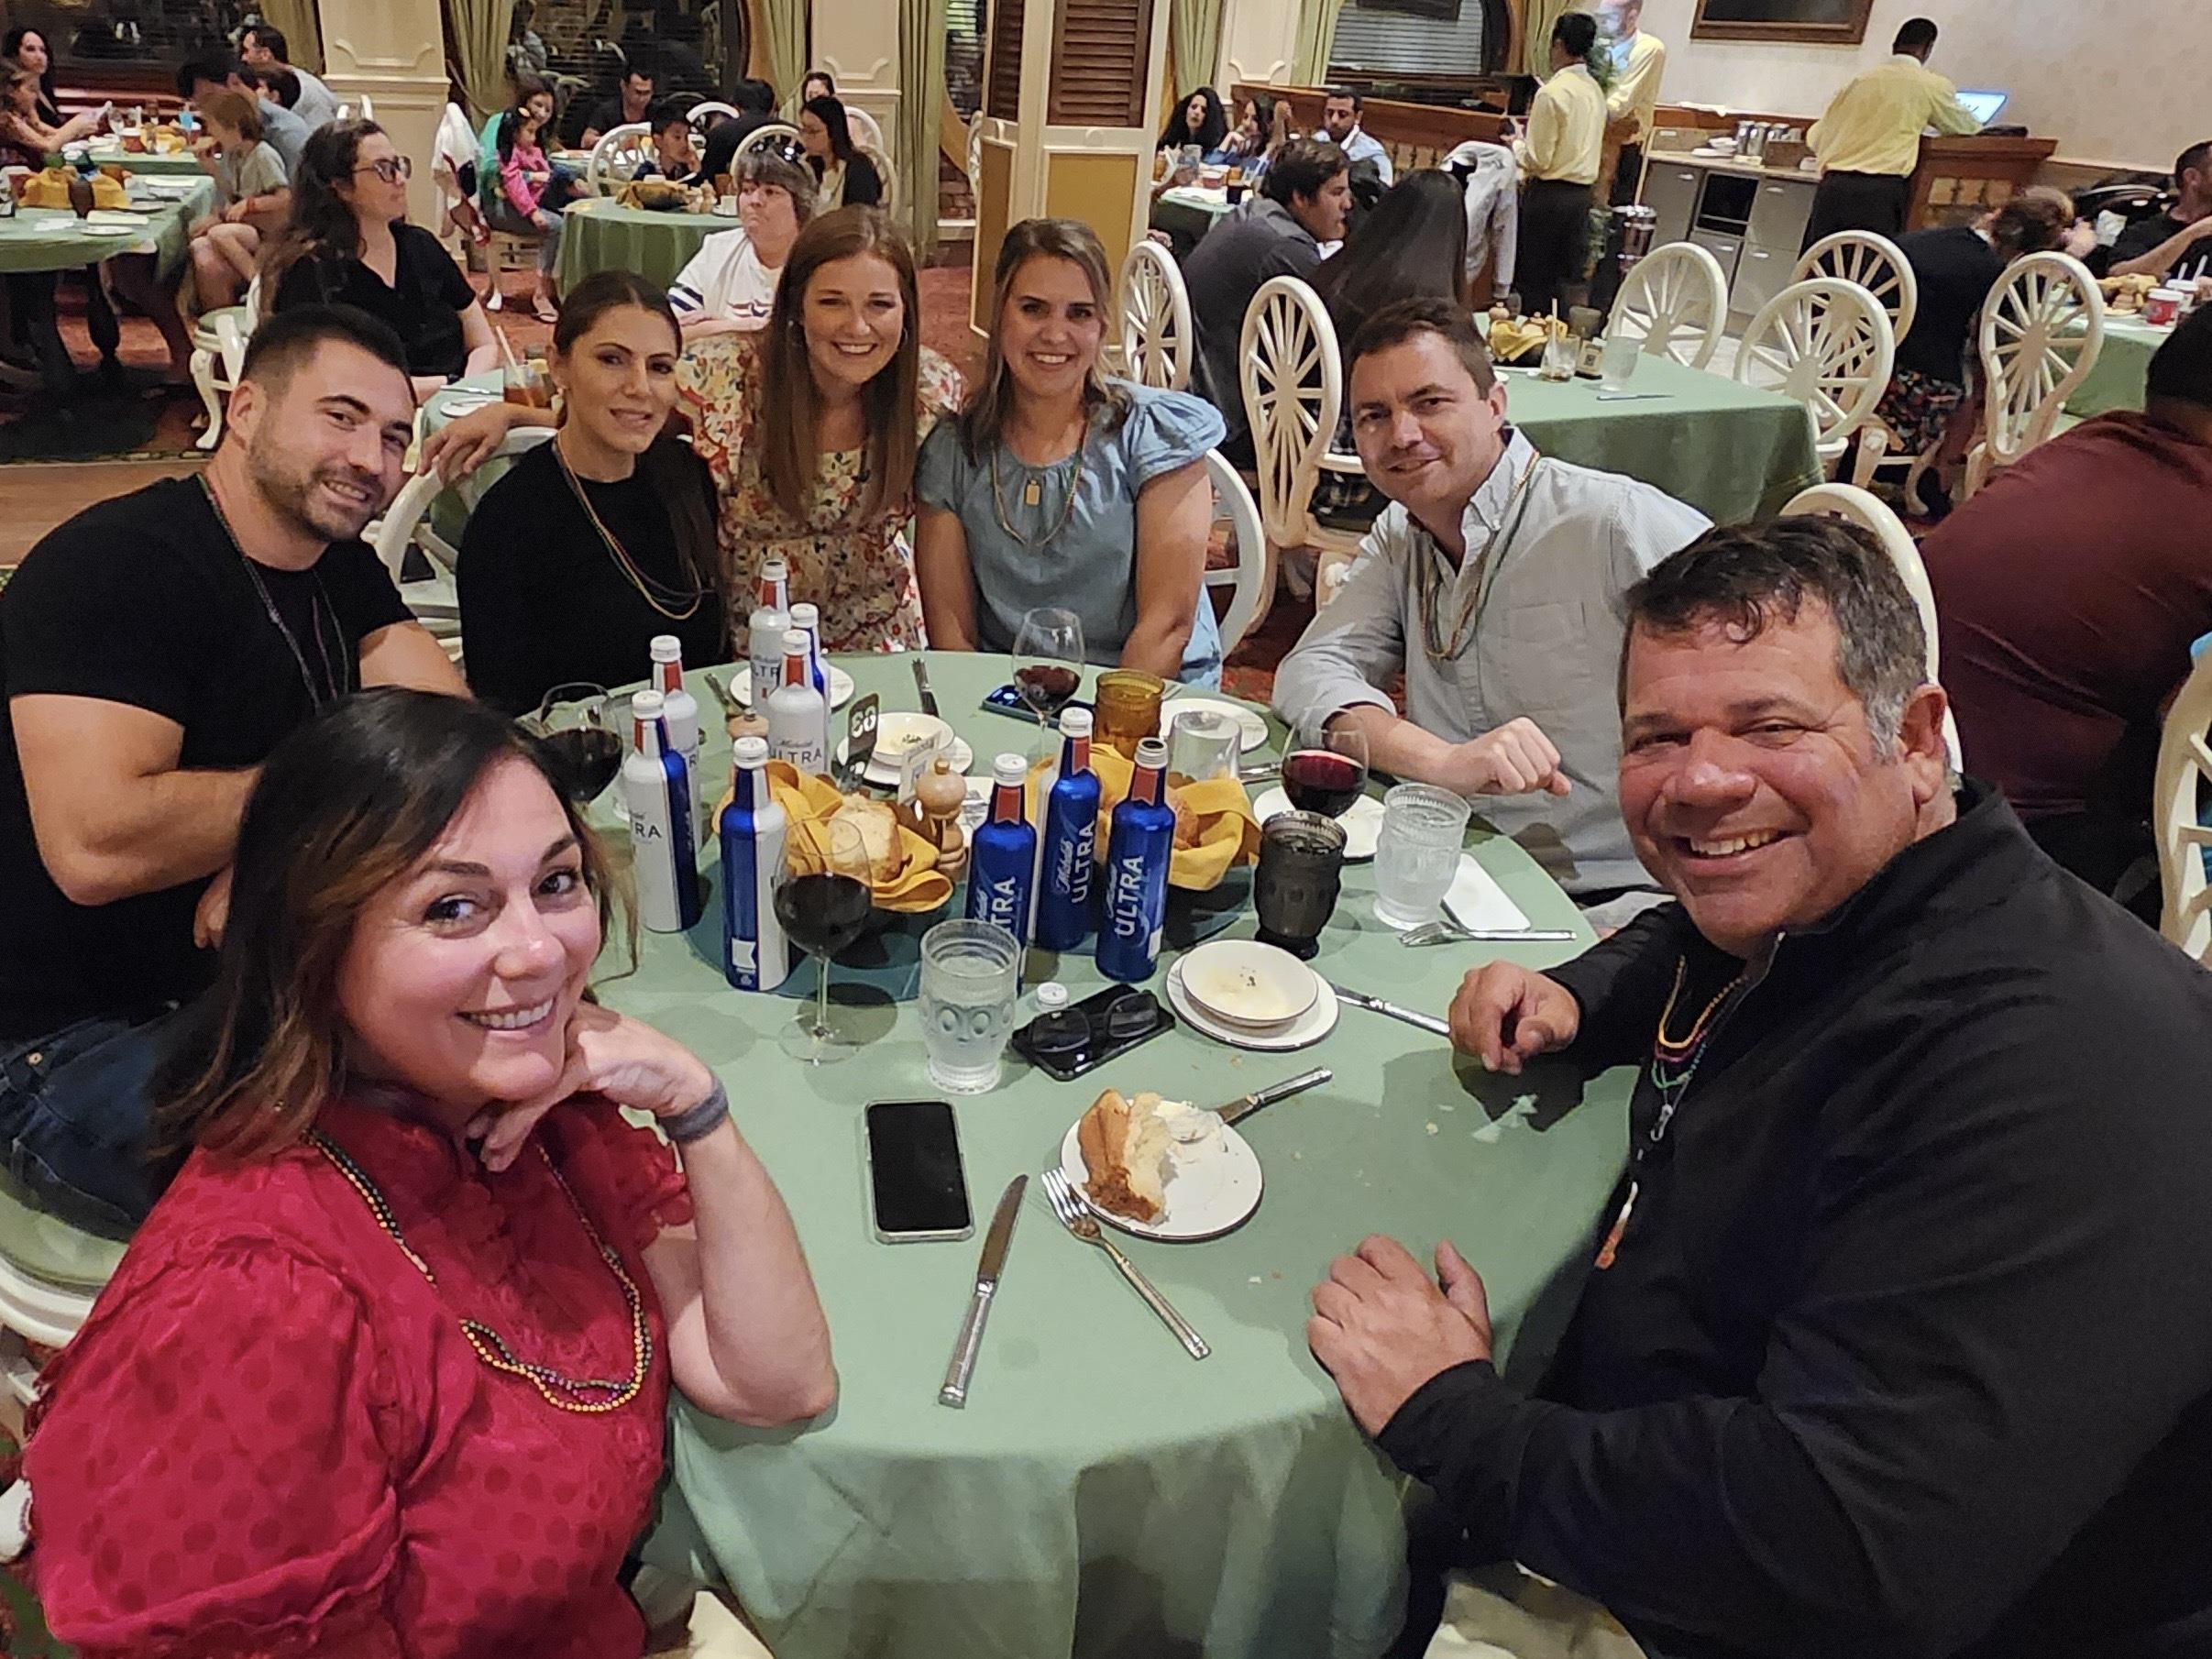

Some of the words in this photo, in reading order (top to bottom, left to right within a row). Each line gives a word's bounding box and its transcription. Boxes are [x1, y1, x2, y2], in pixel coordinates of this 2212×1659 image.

[1071, 819, 1095, 904] ULTRA
[1114, 855, 1145, 937] ULTRA
[991, 875, 1017, 932] TRA
